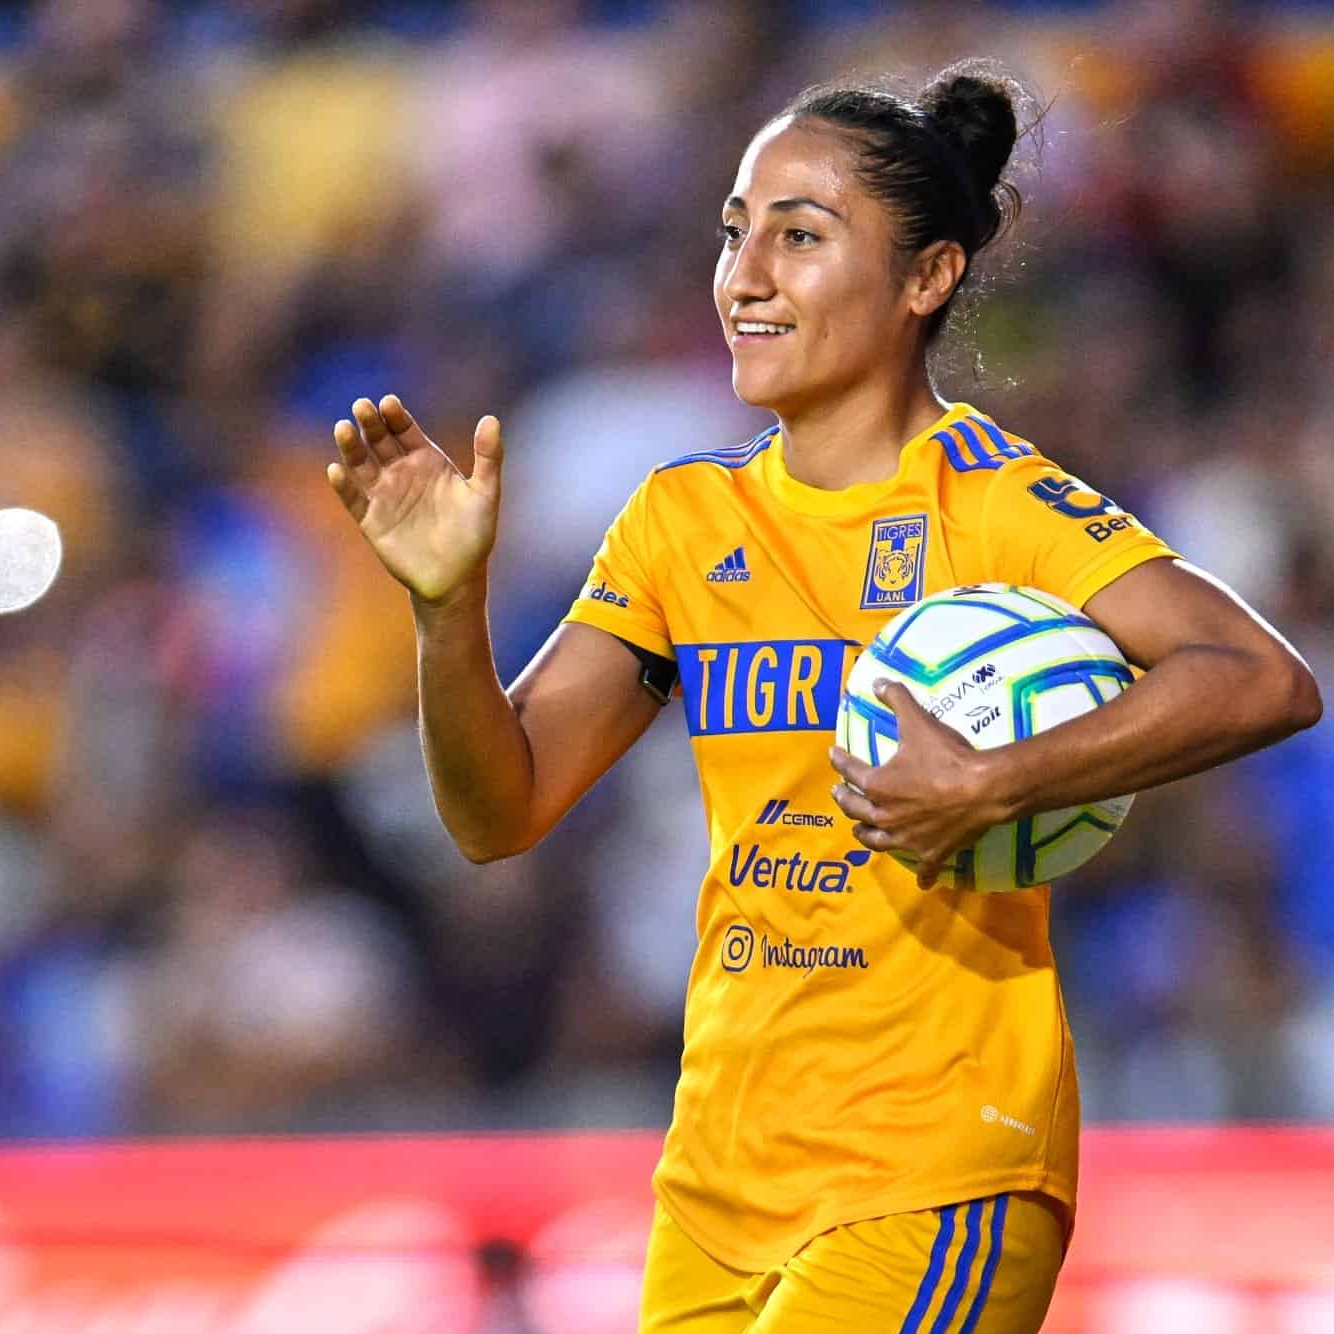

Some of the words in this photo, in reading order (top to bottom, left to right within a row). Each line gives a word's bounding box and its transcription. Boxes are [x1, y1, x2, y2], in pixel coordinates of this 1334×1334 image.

[877, 523, 922, 540] TIGRES
[706, 569, 751, 582] adidas
[782, 813, 834, 827] CEMEX
[730, 844, 850, 893] Vertua
[761, 934, 869, 979] Instagram
